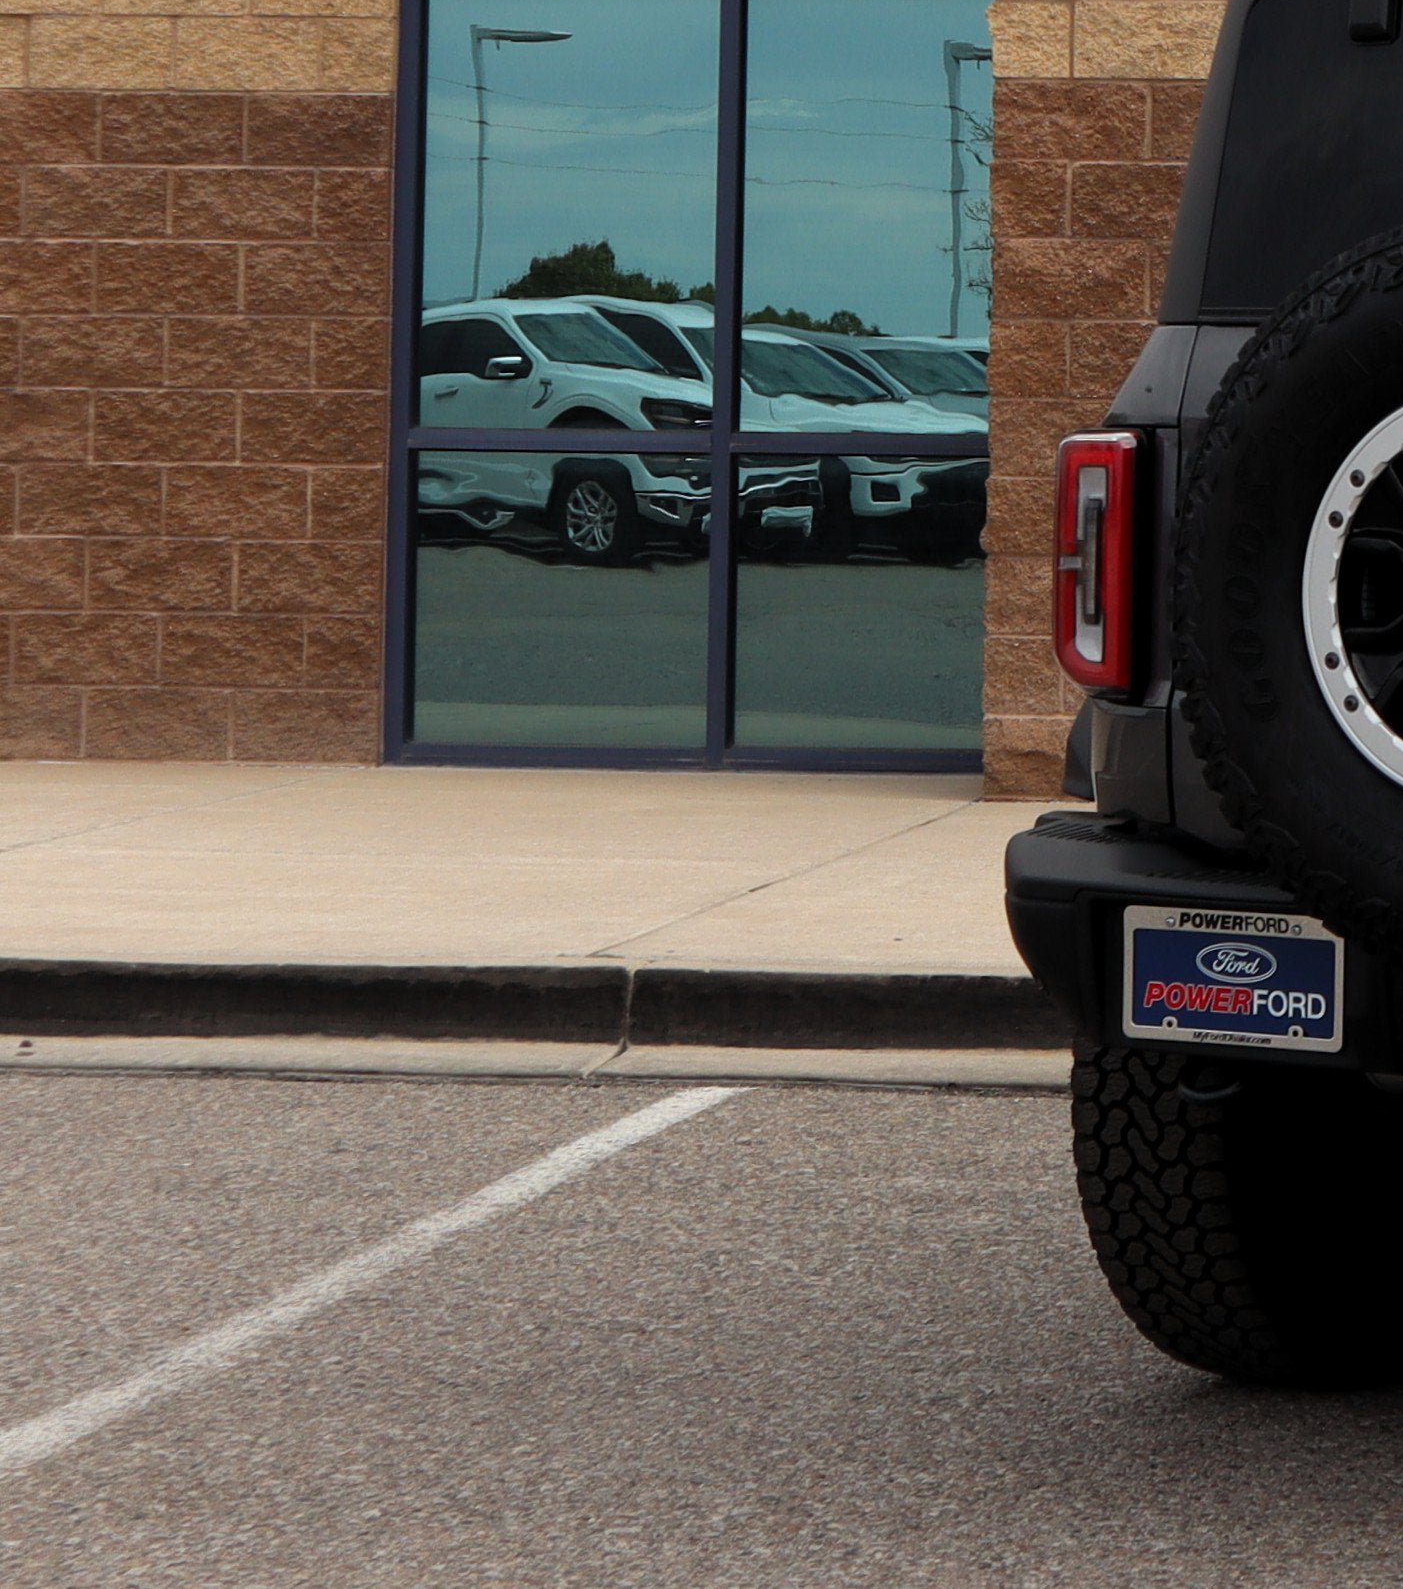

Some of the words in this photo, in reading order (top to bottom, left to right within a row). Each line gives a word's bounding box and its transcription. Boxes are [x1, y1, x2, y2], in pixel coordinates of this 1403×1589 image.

[1179, 912, 1290, 935] POWERFORD
[1212, 948, 1261, 976] Ford
[1143, 981, 1327, 1020] POWERFORD
